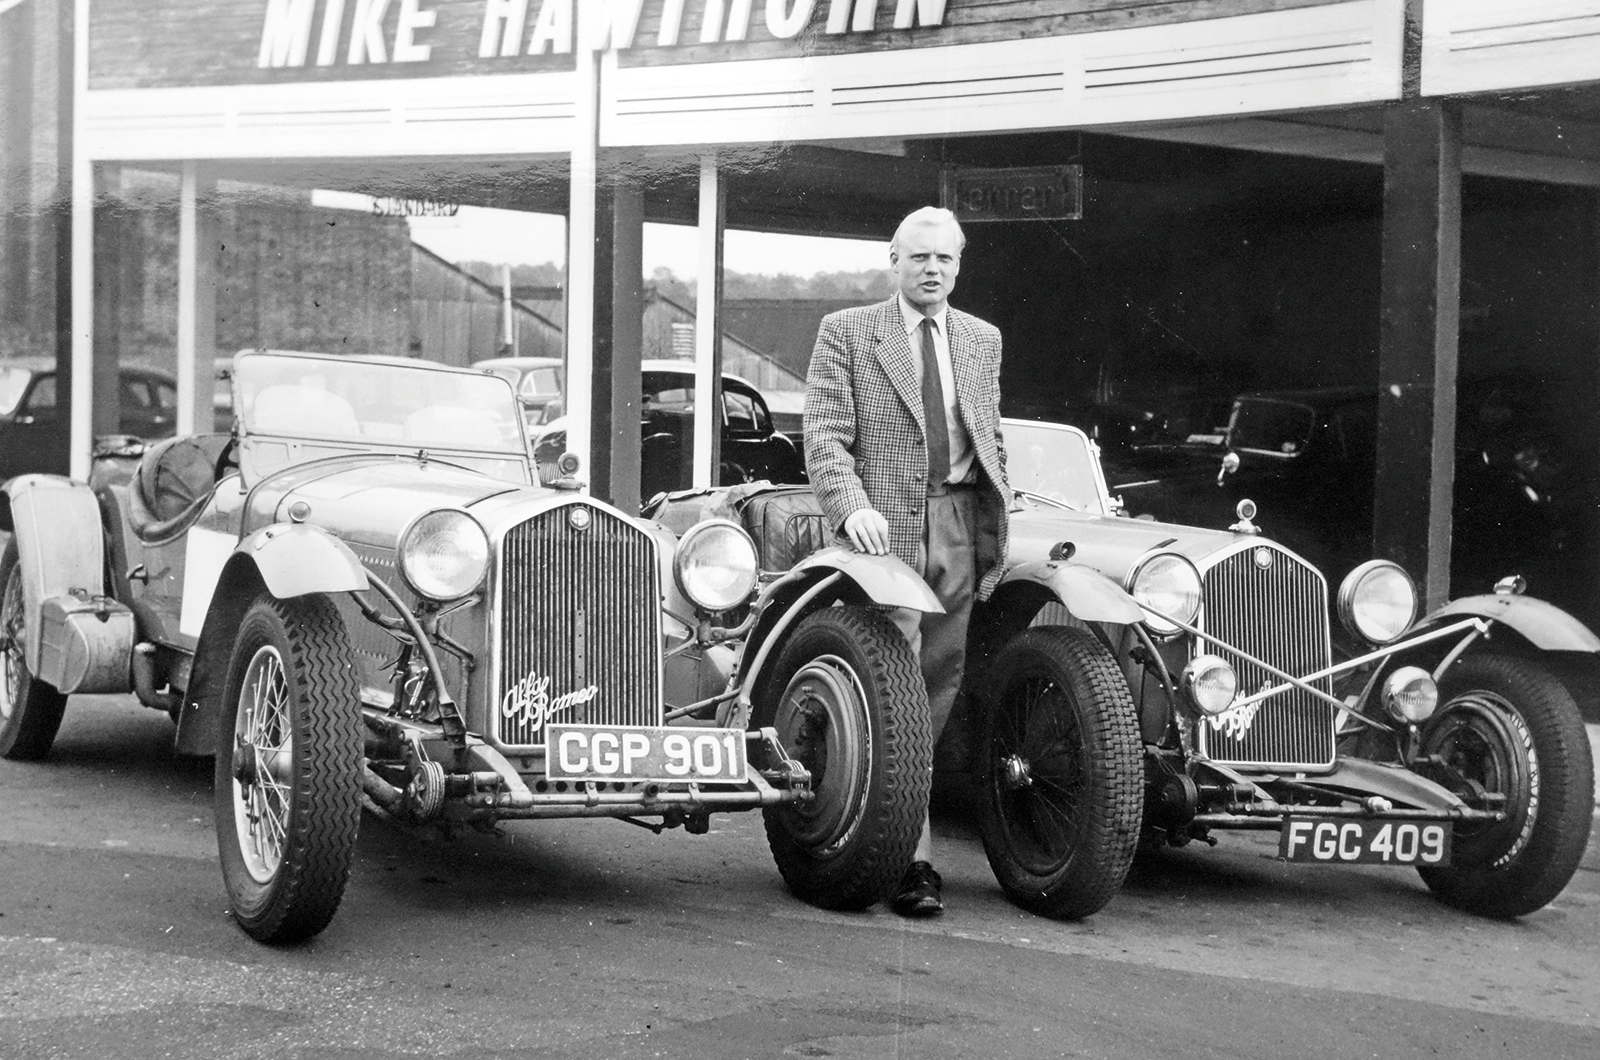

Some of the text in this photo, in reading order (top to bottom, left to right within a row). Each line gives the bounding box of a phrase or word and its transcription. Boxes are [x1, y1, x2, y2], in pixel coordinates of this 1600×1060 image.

[256, 0, 947, 68] MIKE HAWT
[503, 671, 550, 727] Alfa
[528, 684, 599, 732] Romeo
[559, 732, 738, 776] CGP 901
[1287, 822, 1444, 862] FGC 409
